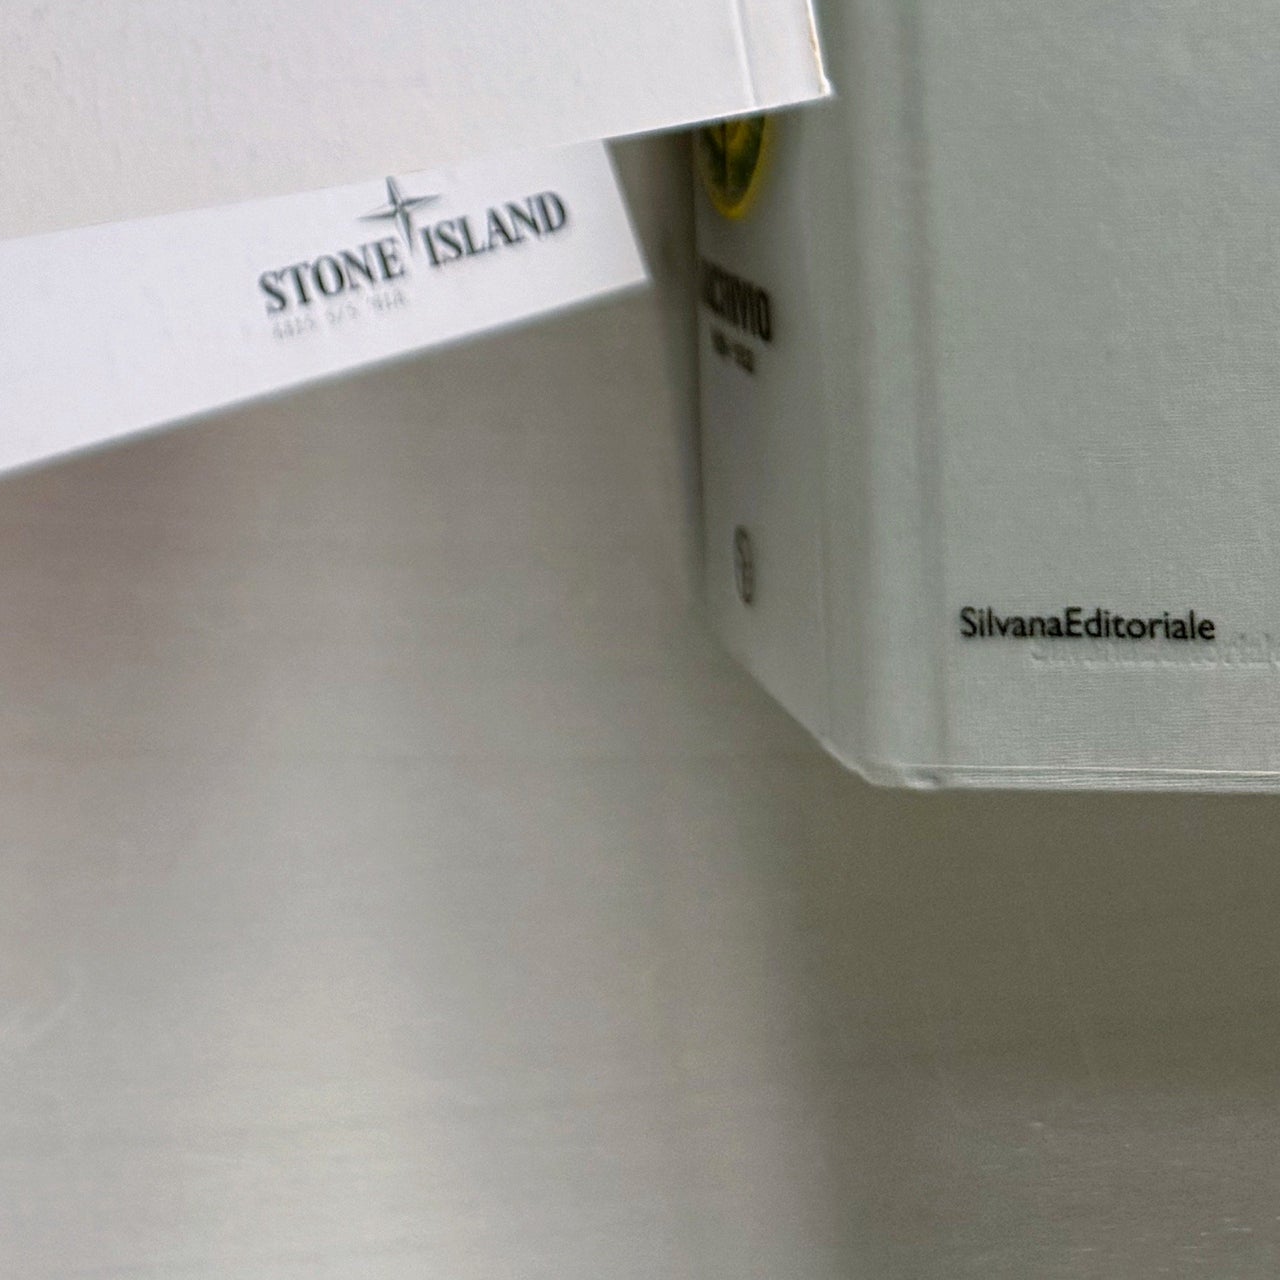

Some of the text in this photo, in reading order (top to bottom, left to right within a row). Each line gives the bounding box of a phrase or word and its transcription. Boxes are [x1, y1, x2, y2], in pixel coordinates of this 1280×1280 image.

[258, 236, 406, 316] STONE
[419, 190, 568, 268] ISLAND
[960, 605, 1216, 641] SilvanaEditoriale
